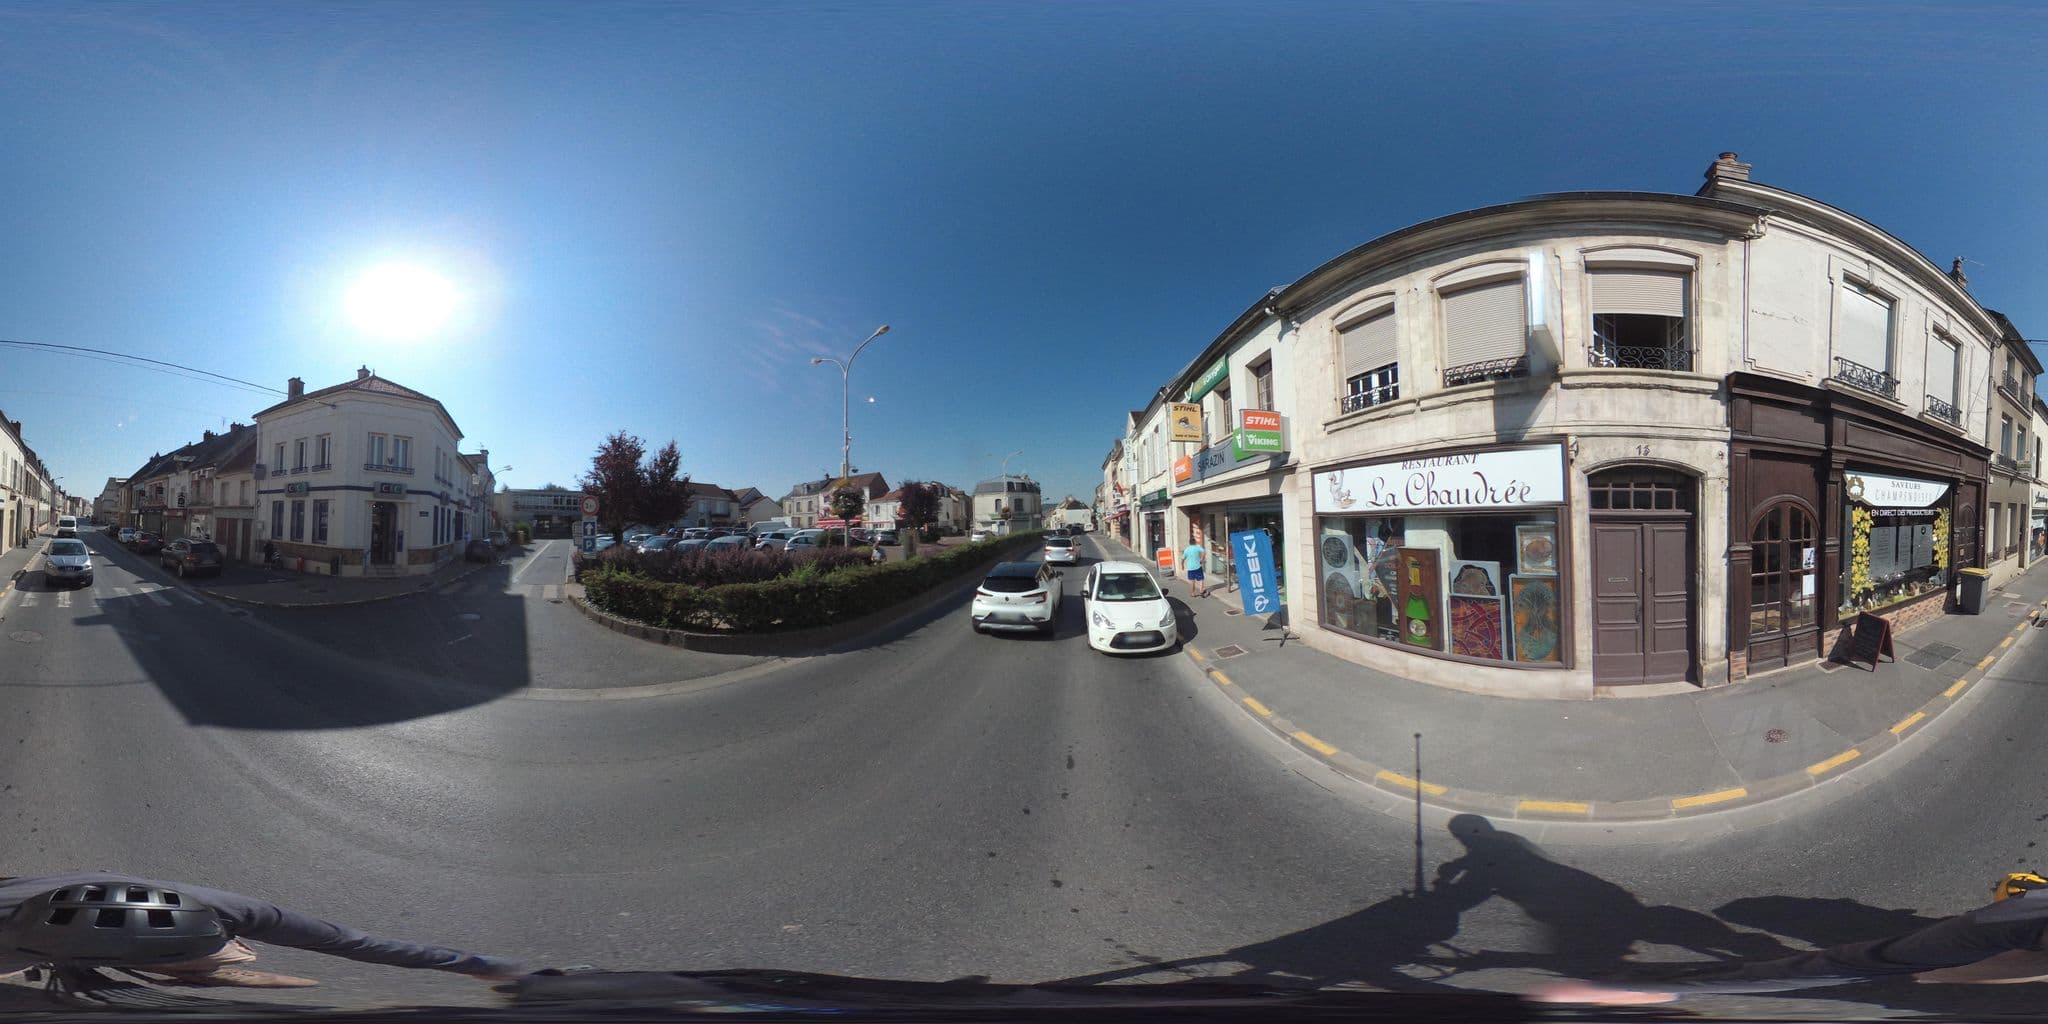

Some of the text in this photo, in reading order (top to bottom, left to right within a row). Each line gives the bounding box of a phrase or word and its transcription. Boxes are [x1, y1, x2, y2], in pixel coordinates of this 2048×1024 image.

[1173, 405, 1197, 413] STIHL
[1245, 416, 1278, 426] STIHL
[1247, 434, 1278, 446] VIKING
[1402, 454, 1479, 470] RESTAURANT
[1367, 471, 1534, 507] La Chaudrée
[1891, 481, 1920, 489] SAVEURS
[1871, 509, 1879, 517] EN
